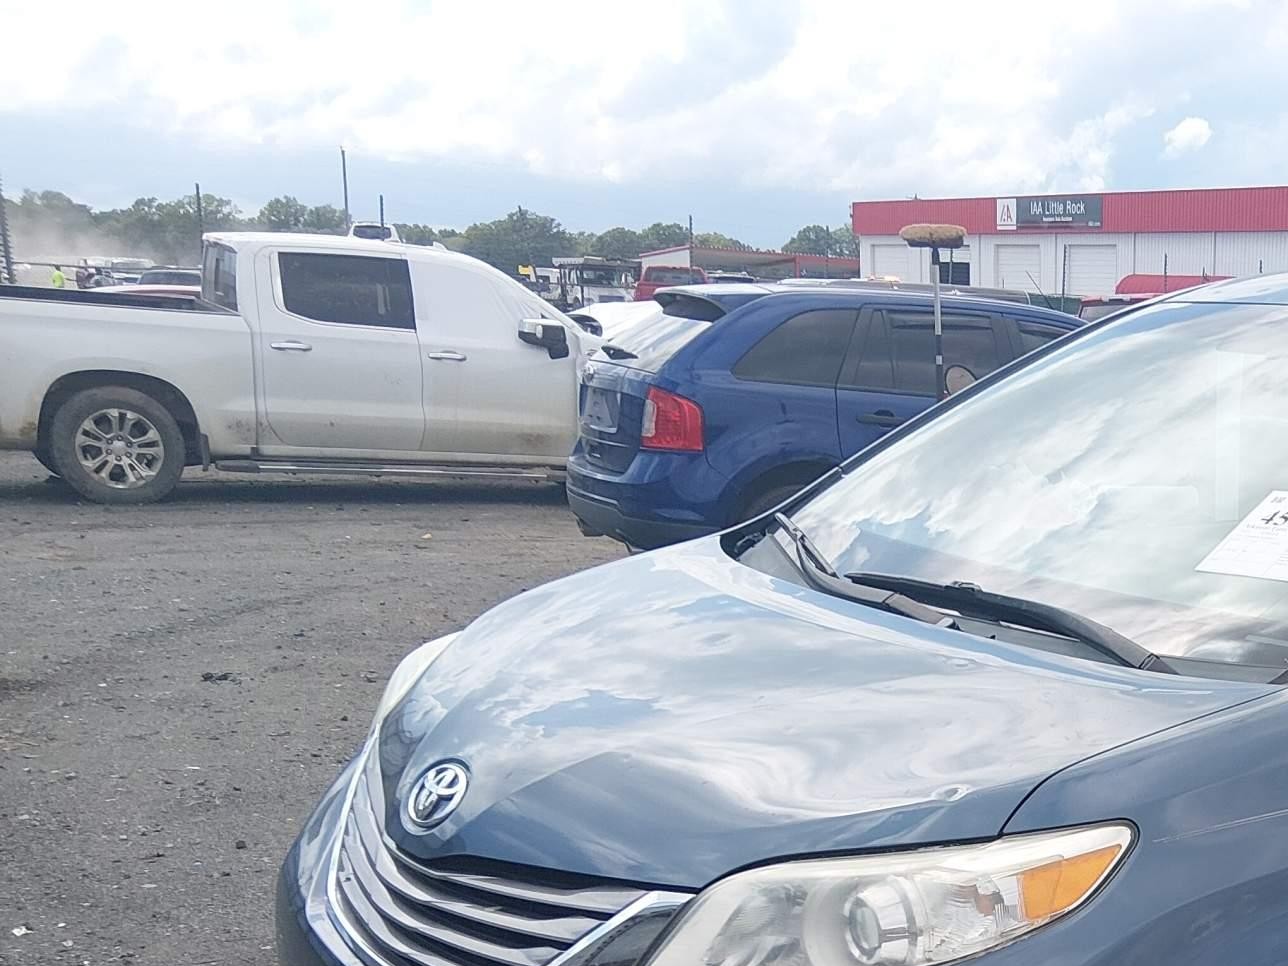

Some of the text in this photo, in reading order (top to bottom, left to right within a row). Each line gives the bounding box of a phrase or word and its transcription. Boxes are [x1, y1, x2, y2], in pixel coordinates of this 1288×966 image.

[1030, 200, 1086, 215] IAA Little Rock
